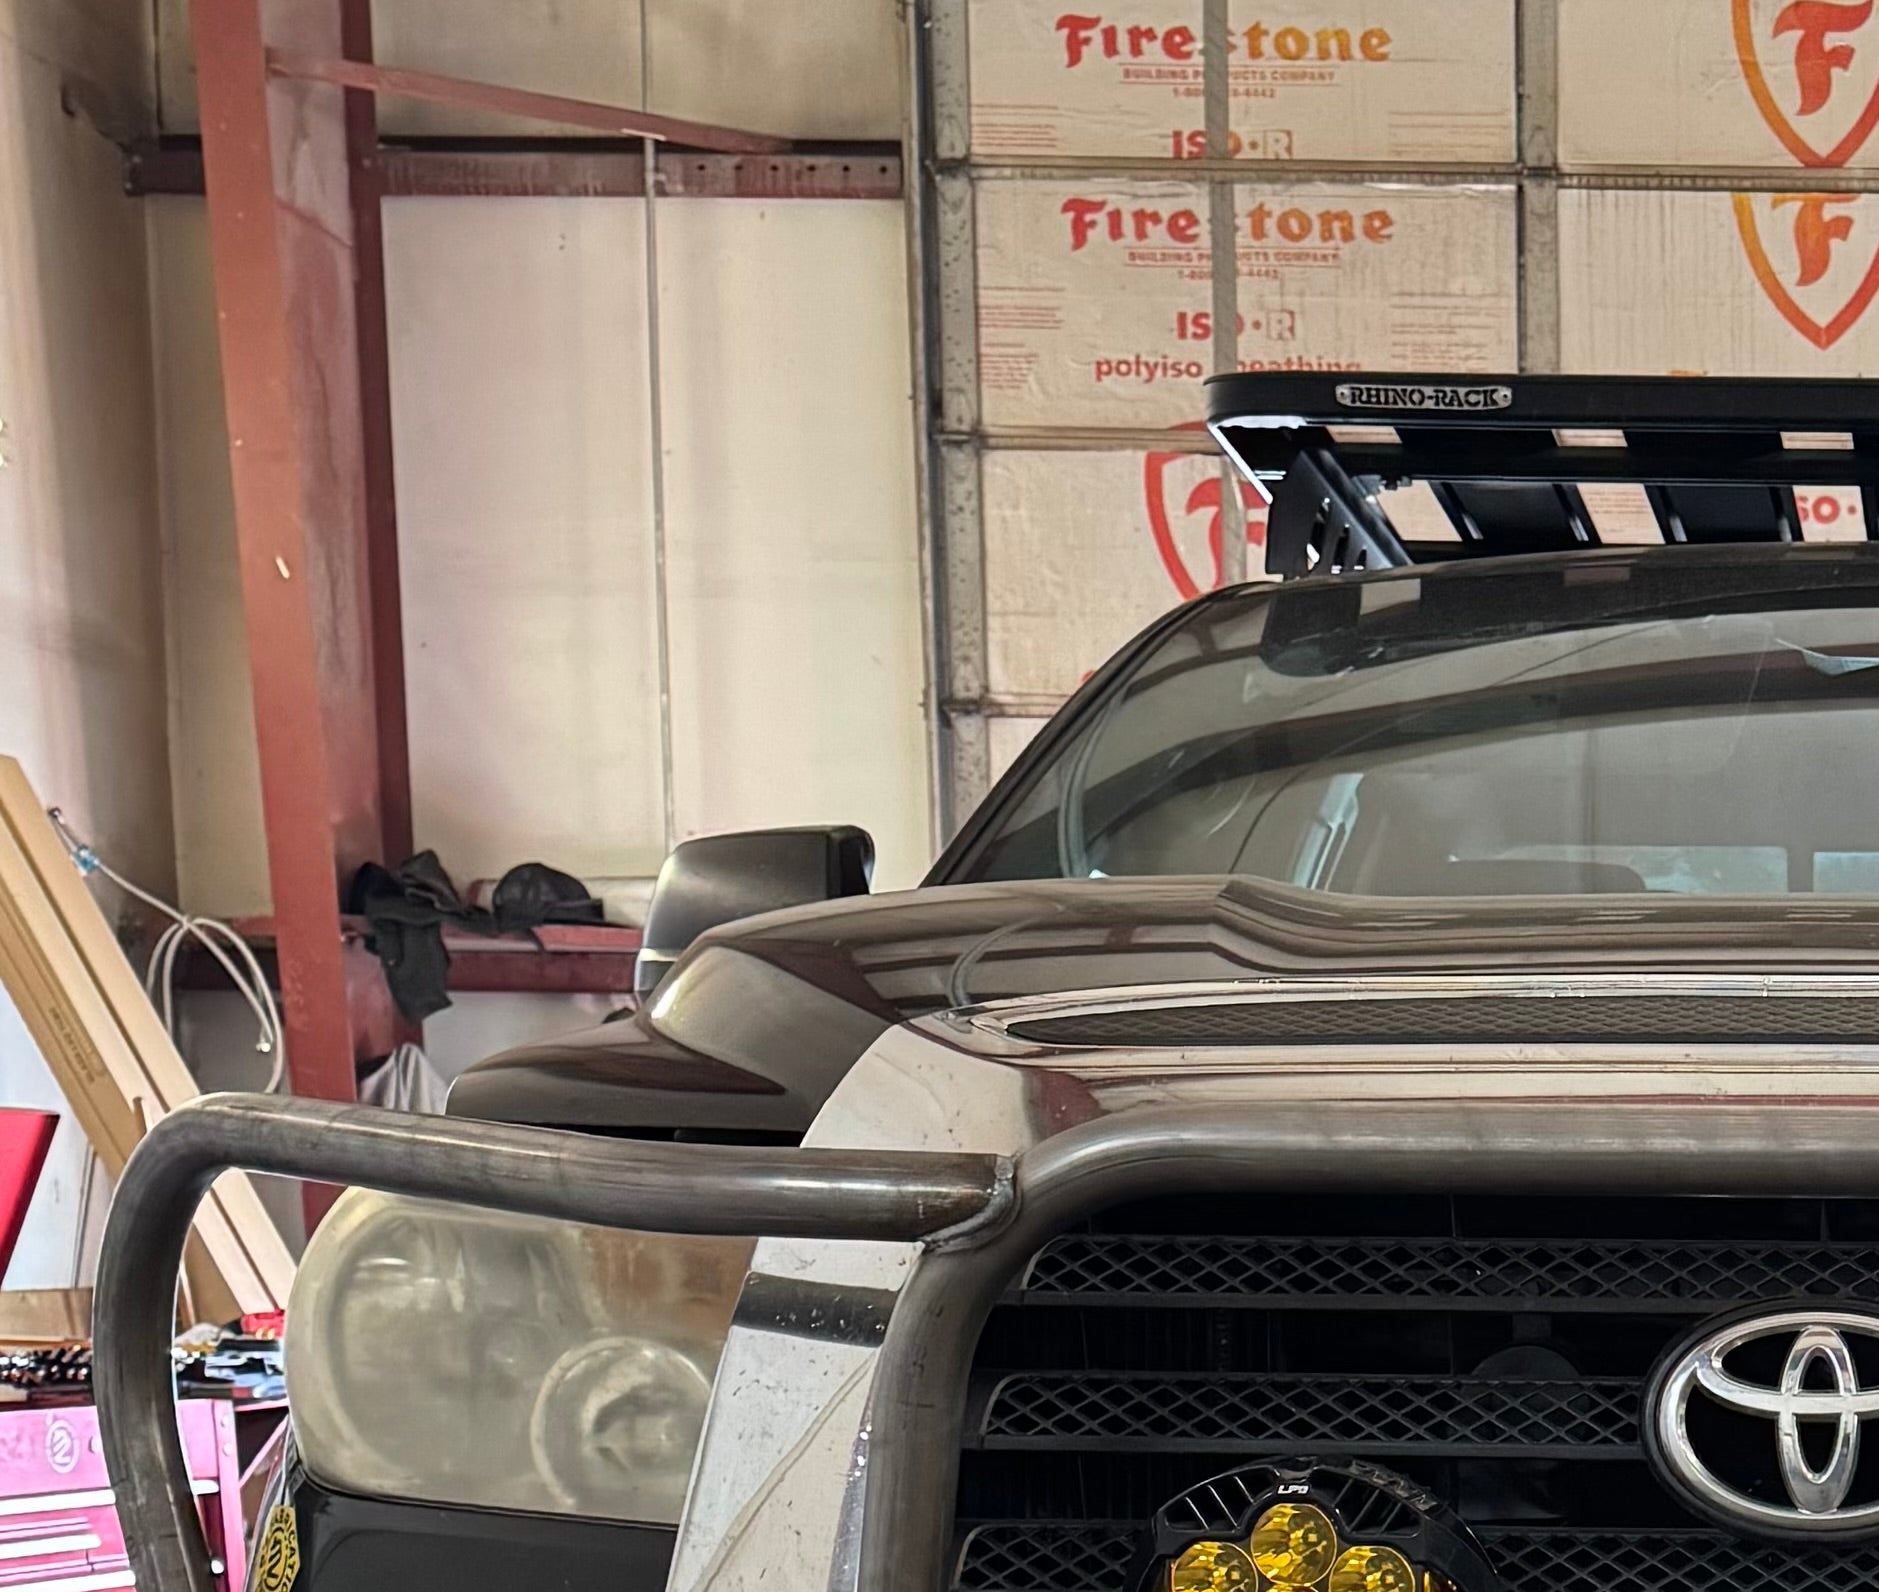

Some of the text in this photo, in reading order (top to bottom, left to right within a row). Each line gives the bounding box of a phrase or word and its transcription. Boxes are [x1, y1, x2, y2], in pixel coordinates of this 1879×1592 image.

[1061, 198, 1393, 251] Firetone
[1095, 354, 1203, 382] polyiso
[1350, 386, 1500, 408] RHINO-RACK
